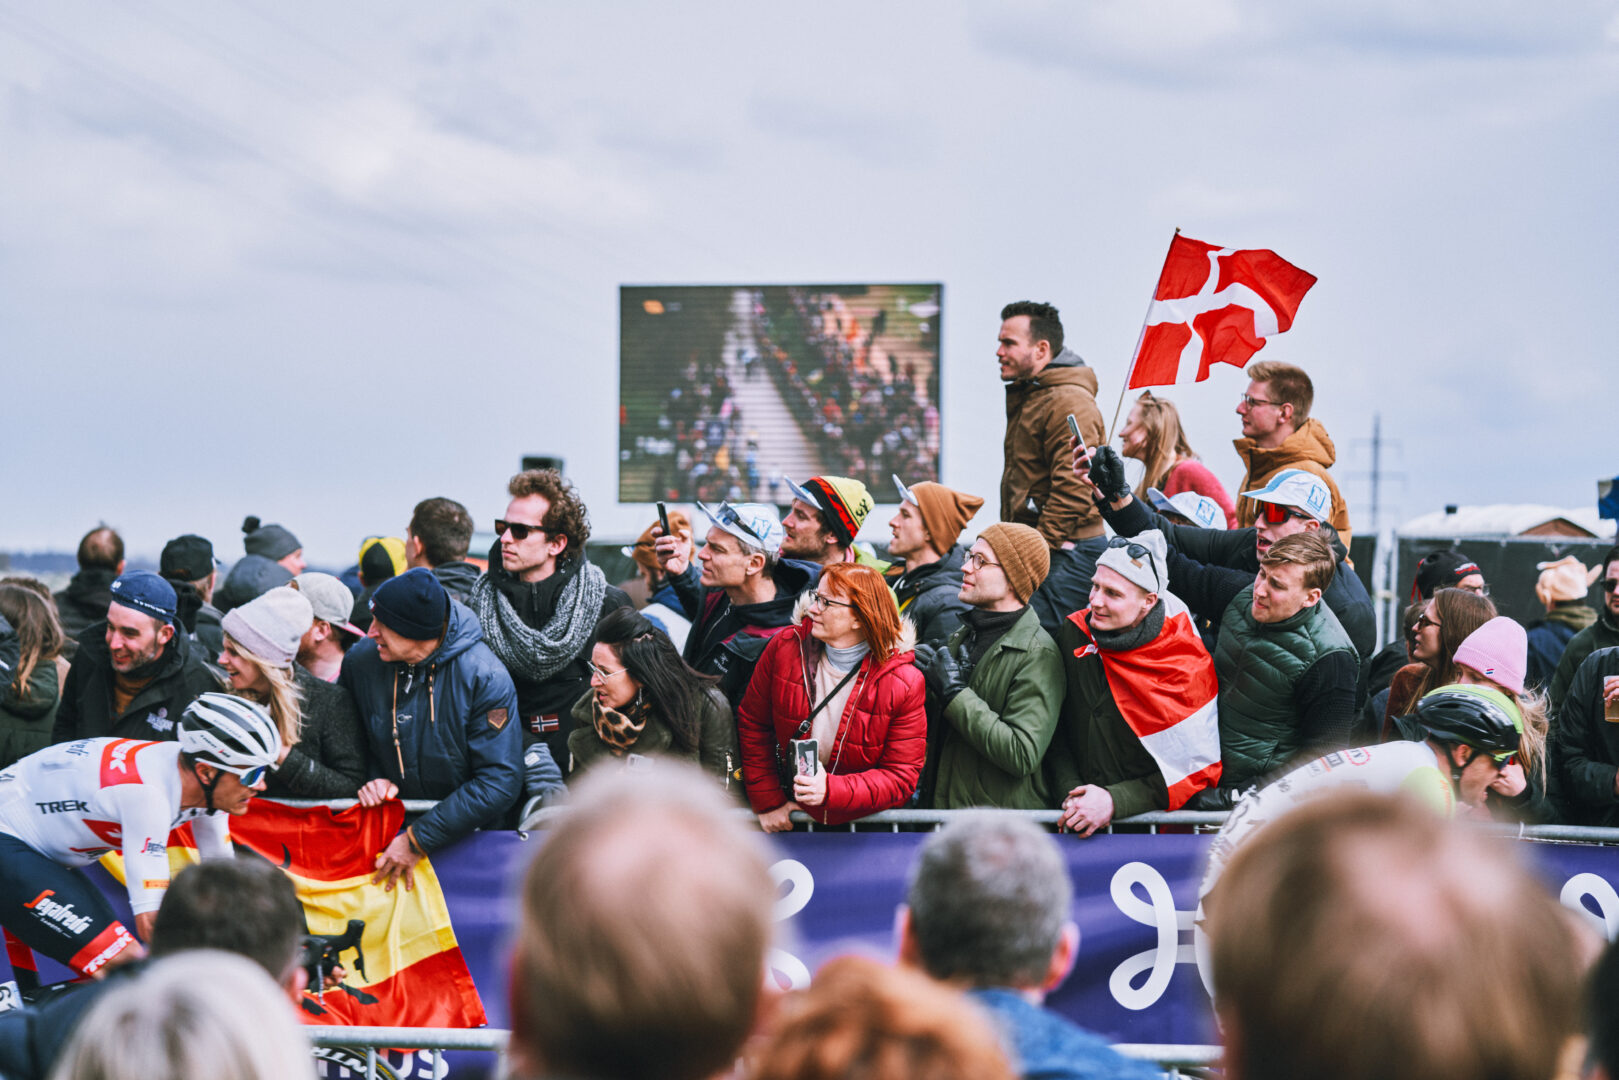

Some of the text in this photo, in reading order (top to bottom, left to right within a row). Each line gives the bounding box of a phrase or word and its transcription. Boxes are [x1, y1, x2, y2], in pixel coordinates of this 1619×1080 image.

[35, 800, 90, 814] TREK
[23, 889, 93, 935] Segafredo
[82, 932, 133, 974] TREK
